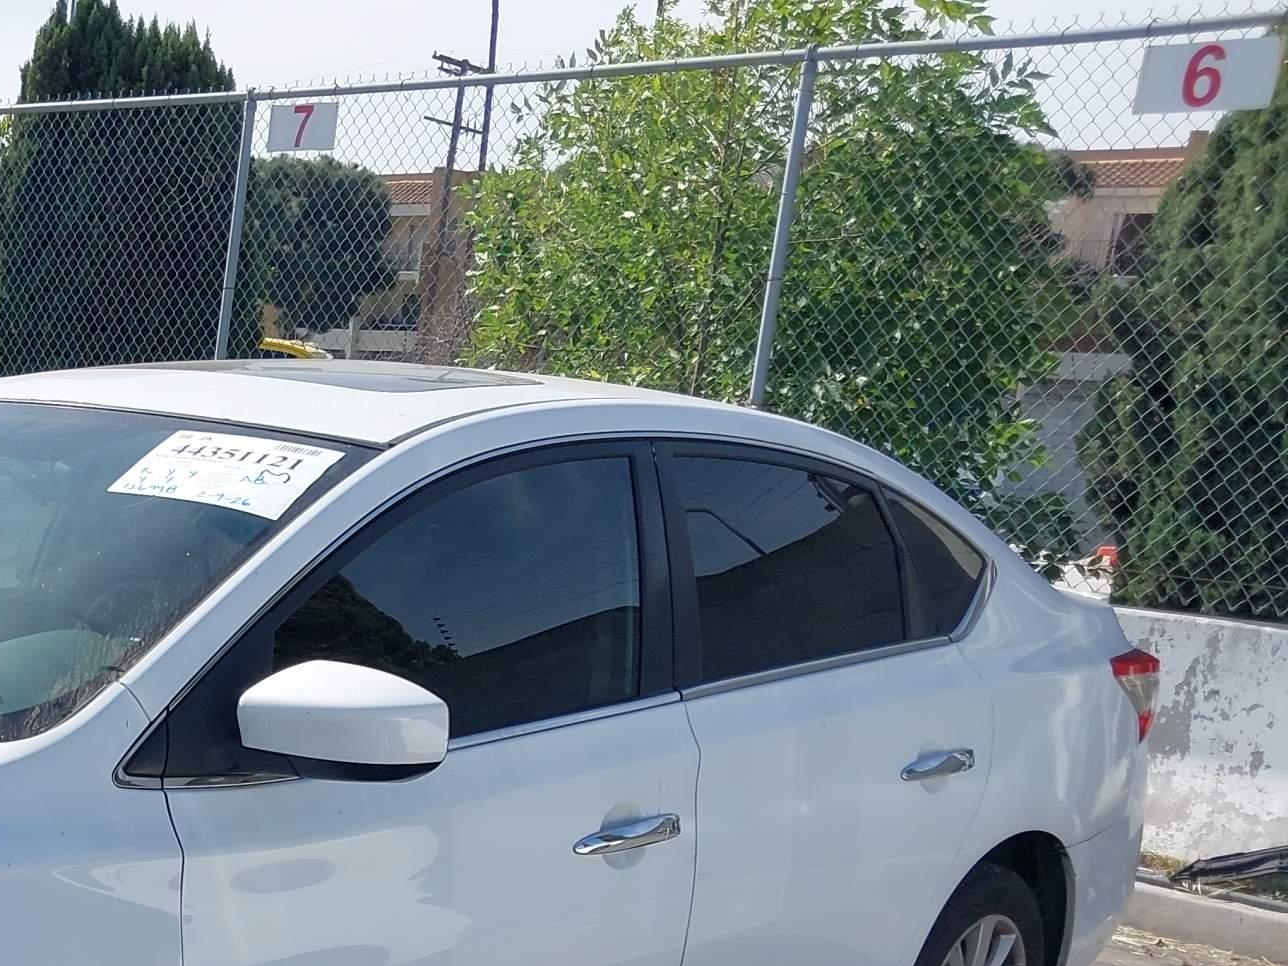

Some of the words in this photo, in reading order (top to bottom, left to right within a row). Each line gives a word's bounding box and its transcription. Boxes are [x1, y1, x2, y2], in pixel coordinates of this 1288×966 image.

[1182, 44, 1226, 108] 6
[294, 105, 315, 148] 7
[171, 444, 304, 471] 44351121
